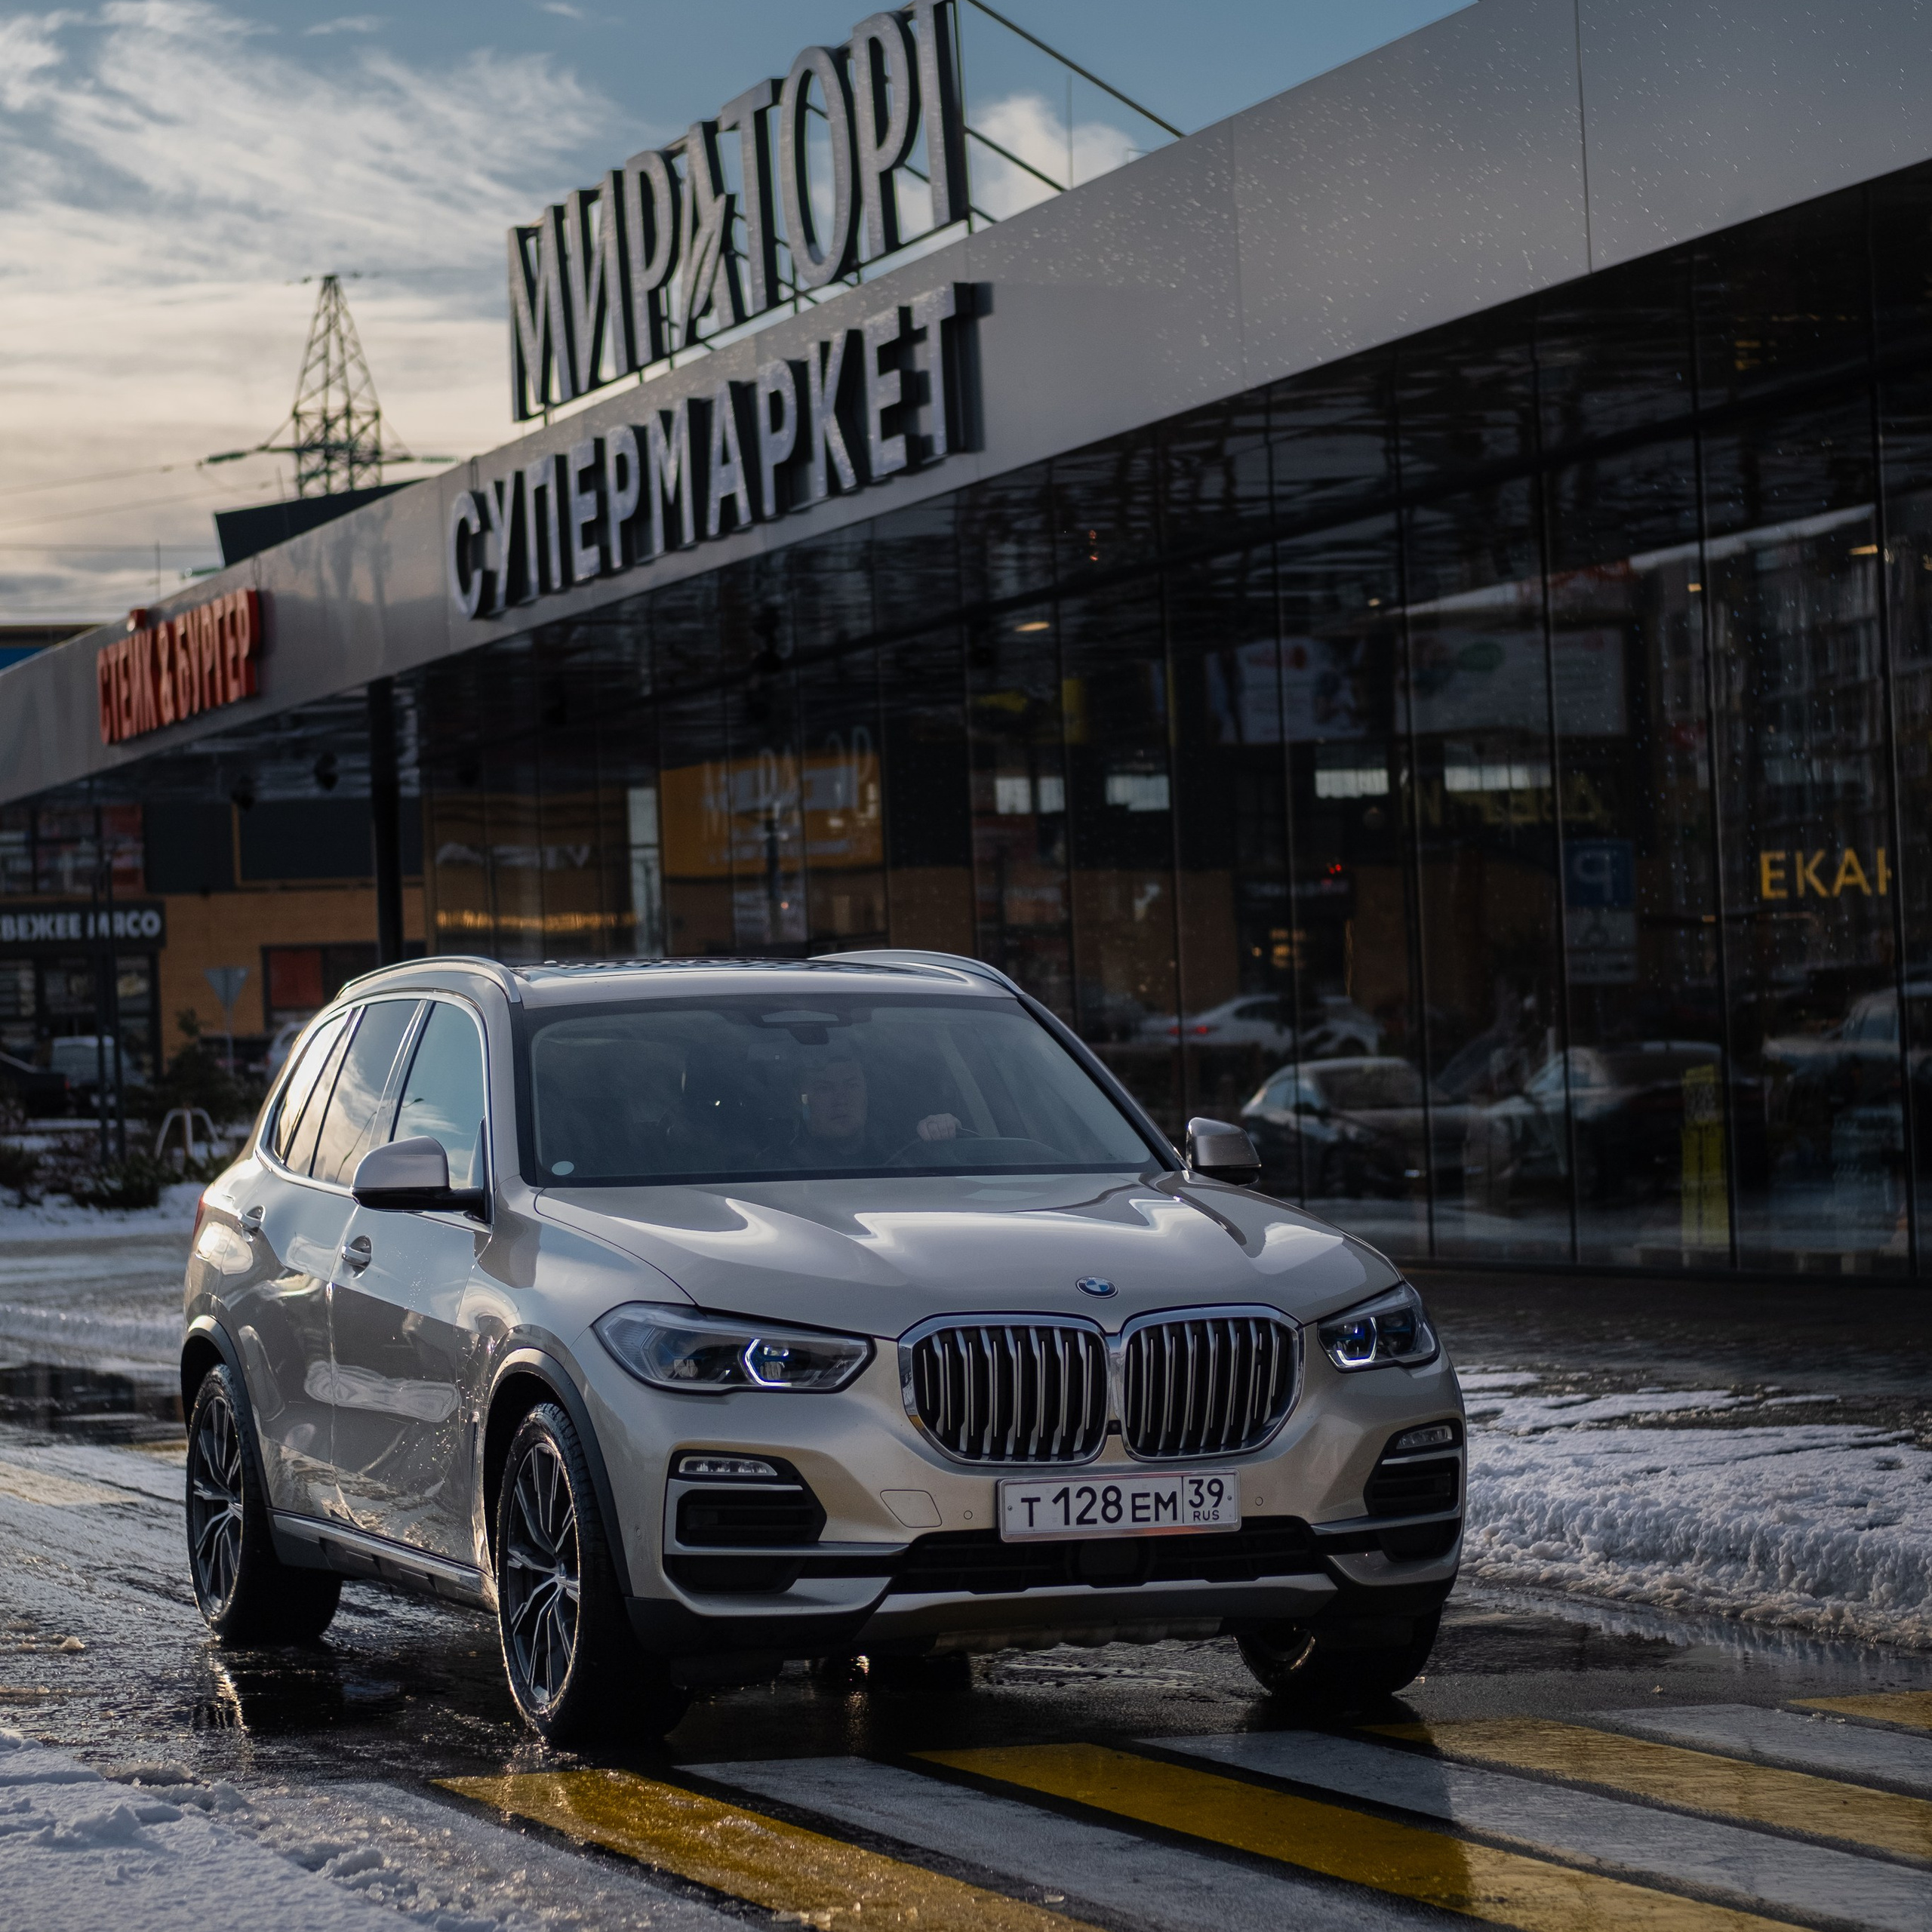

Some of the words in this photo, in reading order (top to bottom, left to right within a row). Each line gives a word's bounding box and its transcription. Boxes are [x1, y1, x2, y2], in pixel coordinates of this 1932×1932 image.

[451, 281, 992, 620] СУПЕРМАРКЕТ
[174, 588, 260, 720] БУРГЕР
[0, 912, 82, 943] ВЕЖЕЕ
[1187, 1478, 1225, 1509] 39
[1192, 1509, 1220, 1521] RUS
